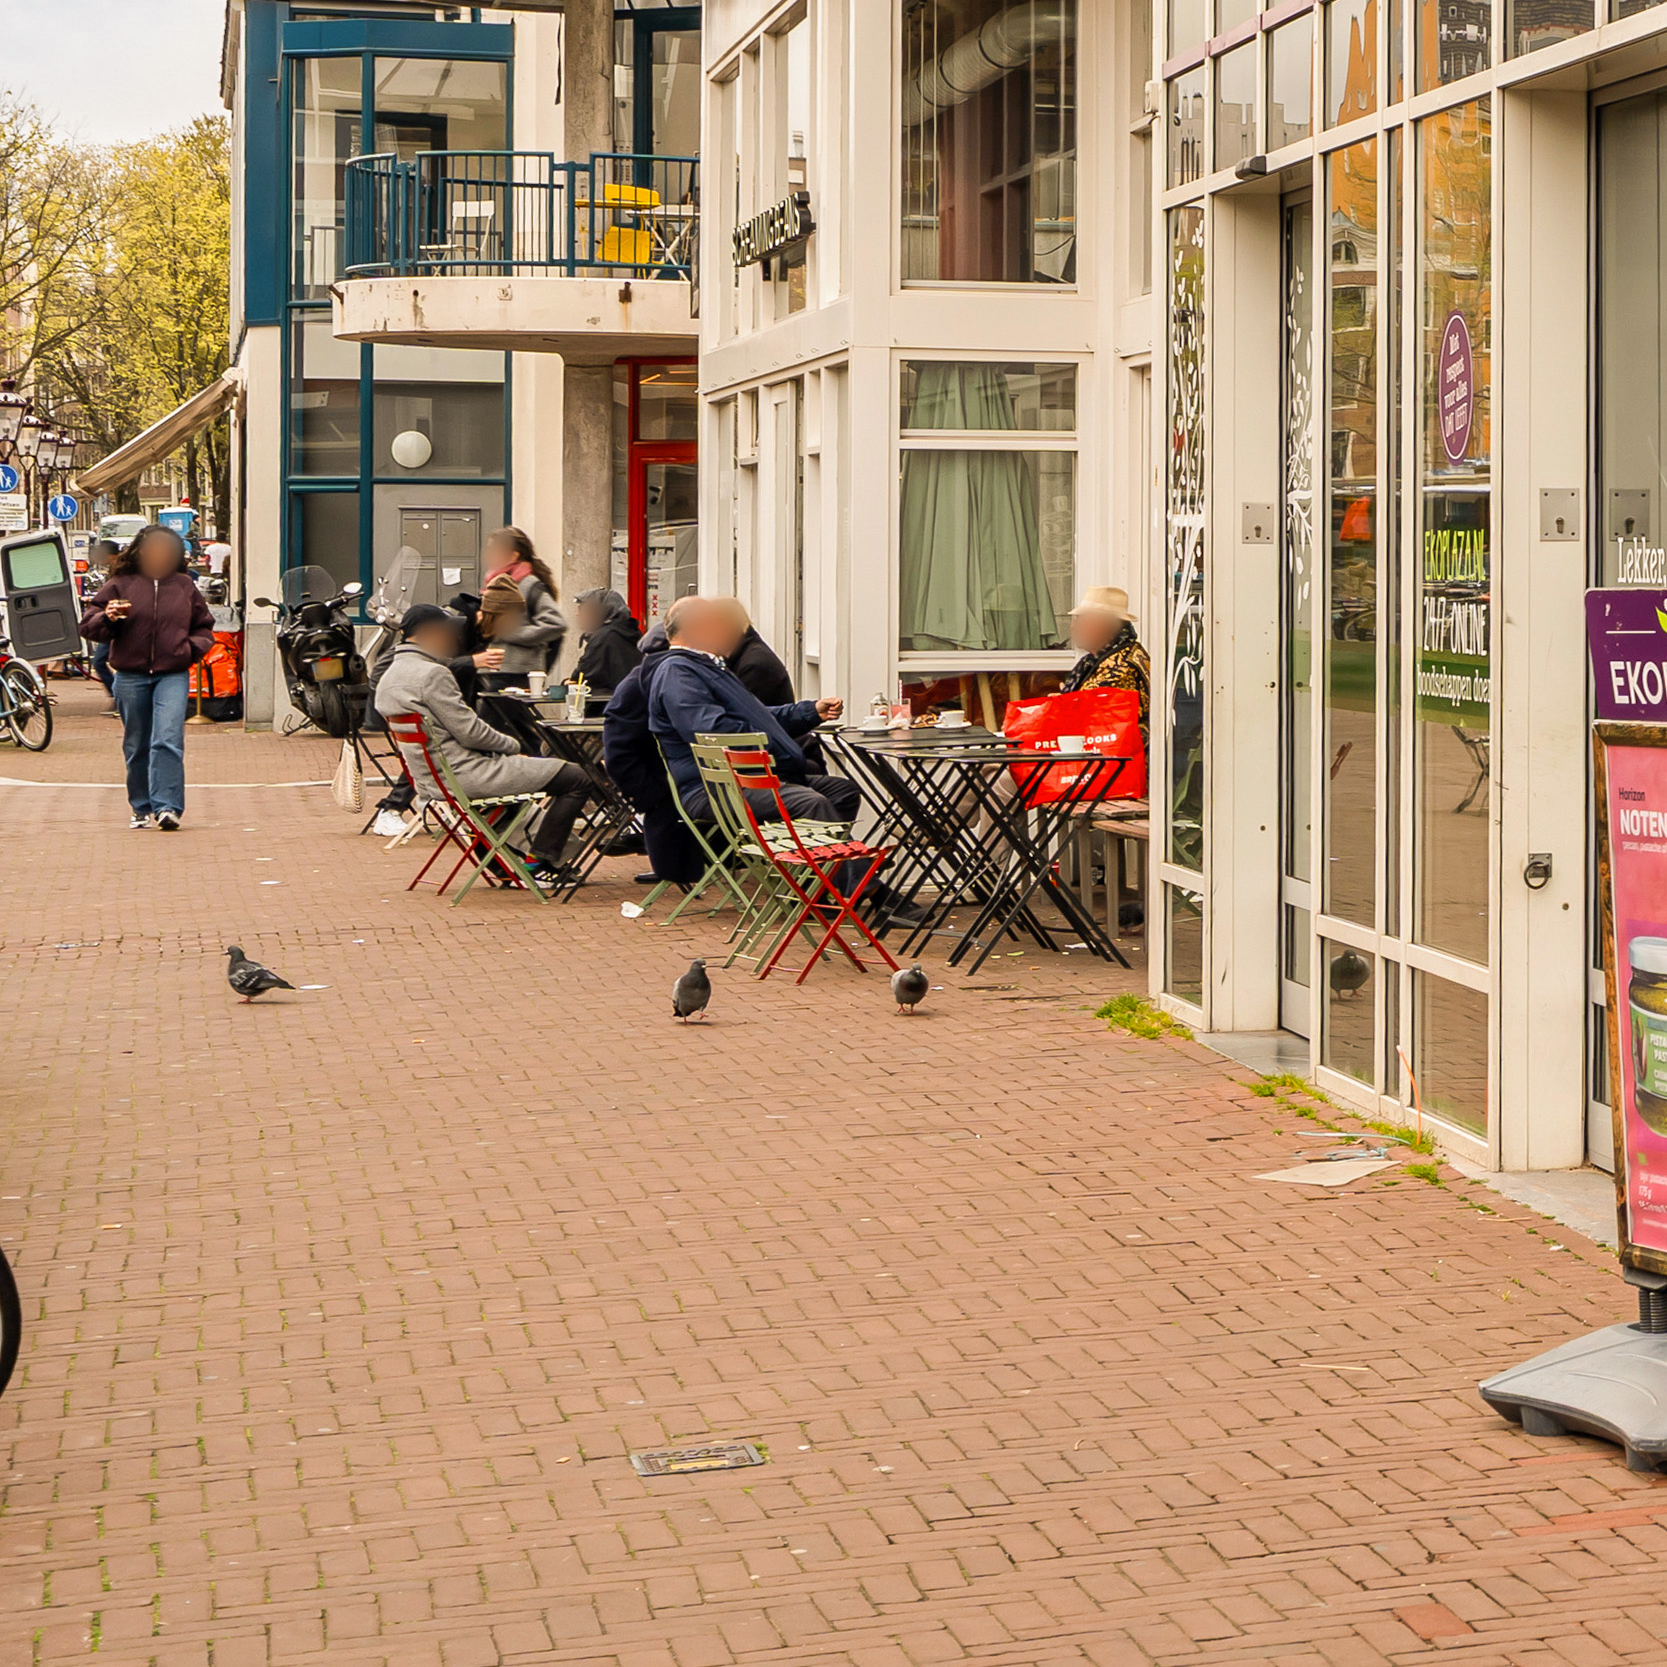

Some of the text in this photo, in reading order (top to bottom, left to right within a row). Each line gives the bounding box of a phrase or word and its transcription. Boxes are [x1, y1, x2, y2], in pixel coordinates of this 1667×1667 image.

[1446, 354, 1465, 384] respect
[1444, 390, 1456, 410] voor
[1617, 537, 1667, 587] Lekker,
[1450, 602, 1487, 656] ONLINE
[1417, 664, 1472, 707] boodschappen
[1618, 787, 1646, 802] Horizon
